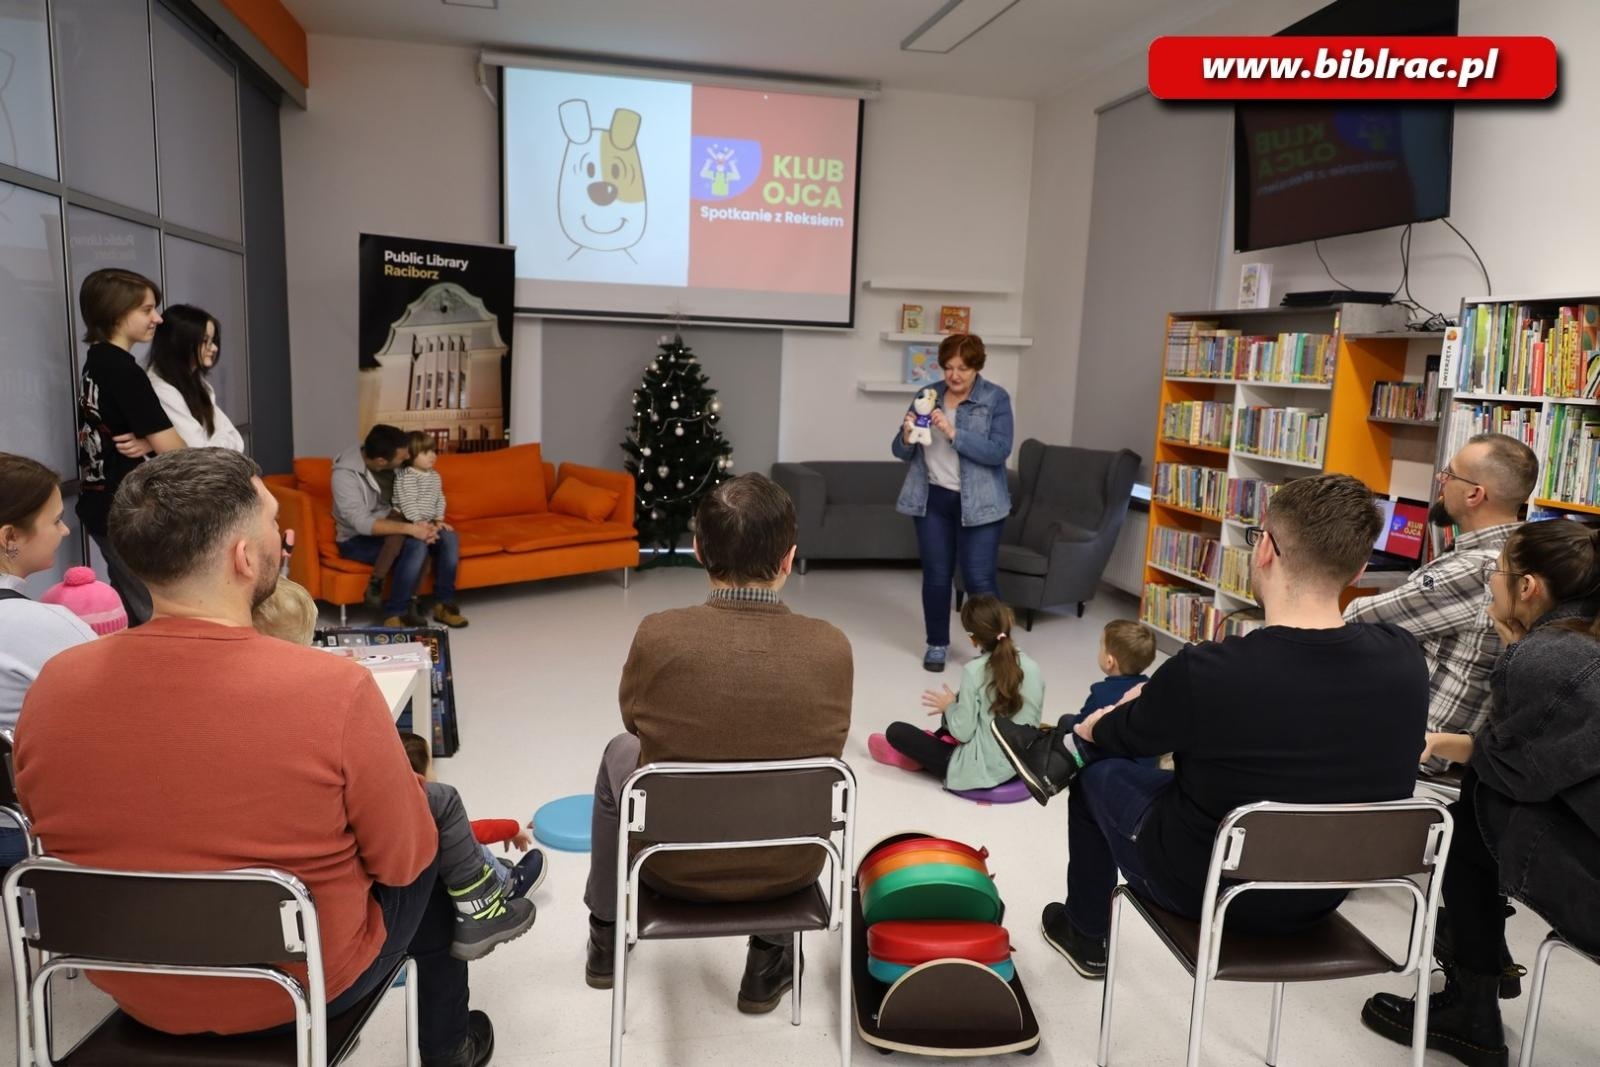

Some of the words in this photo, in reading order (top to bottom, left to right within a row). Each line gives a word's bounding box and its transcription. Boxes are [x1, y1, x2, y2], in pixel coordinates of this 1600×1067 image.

[773, 154, 844, 182] KLUB
[762, 181, 842, 208] OJCA
[700, 206, 773, 223] Spotkanie
[775, 212, 782, 223] z
[785, 211, 844, 227] Reksiem
[384, 250, 424, 265] Public
[426, 254, 469, 272] Library
[384, 264, 440, 280] Raciborz
[431, 636, 440, 664] STAR
